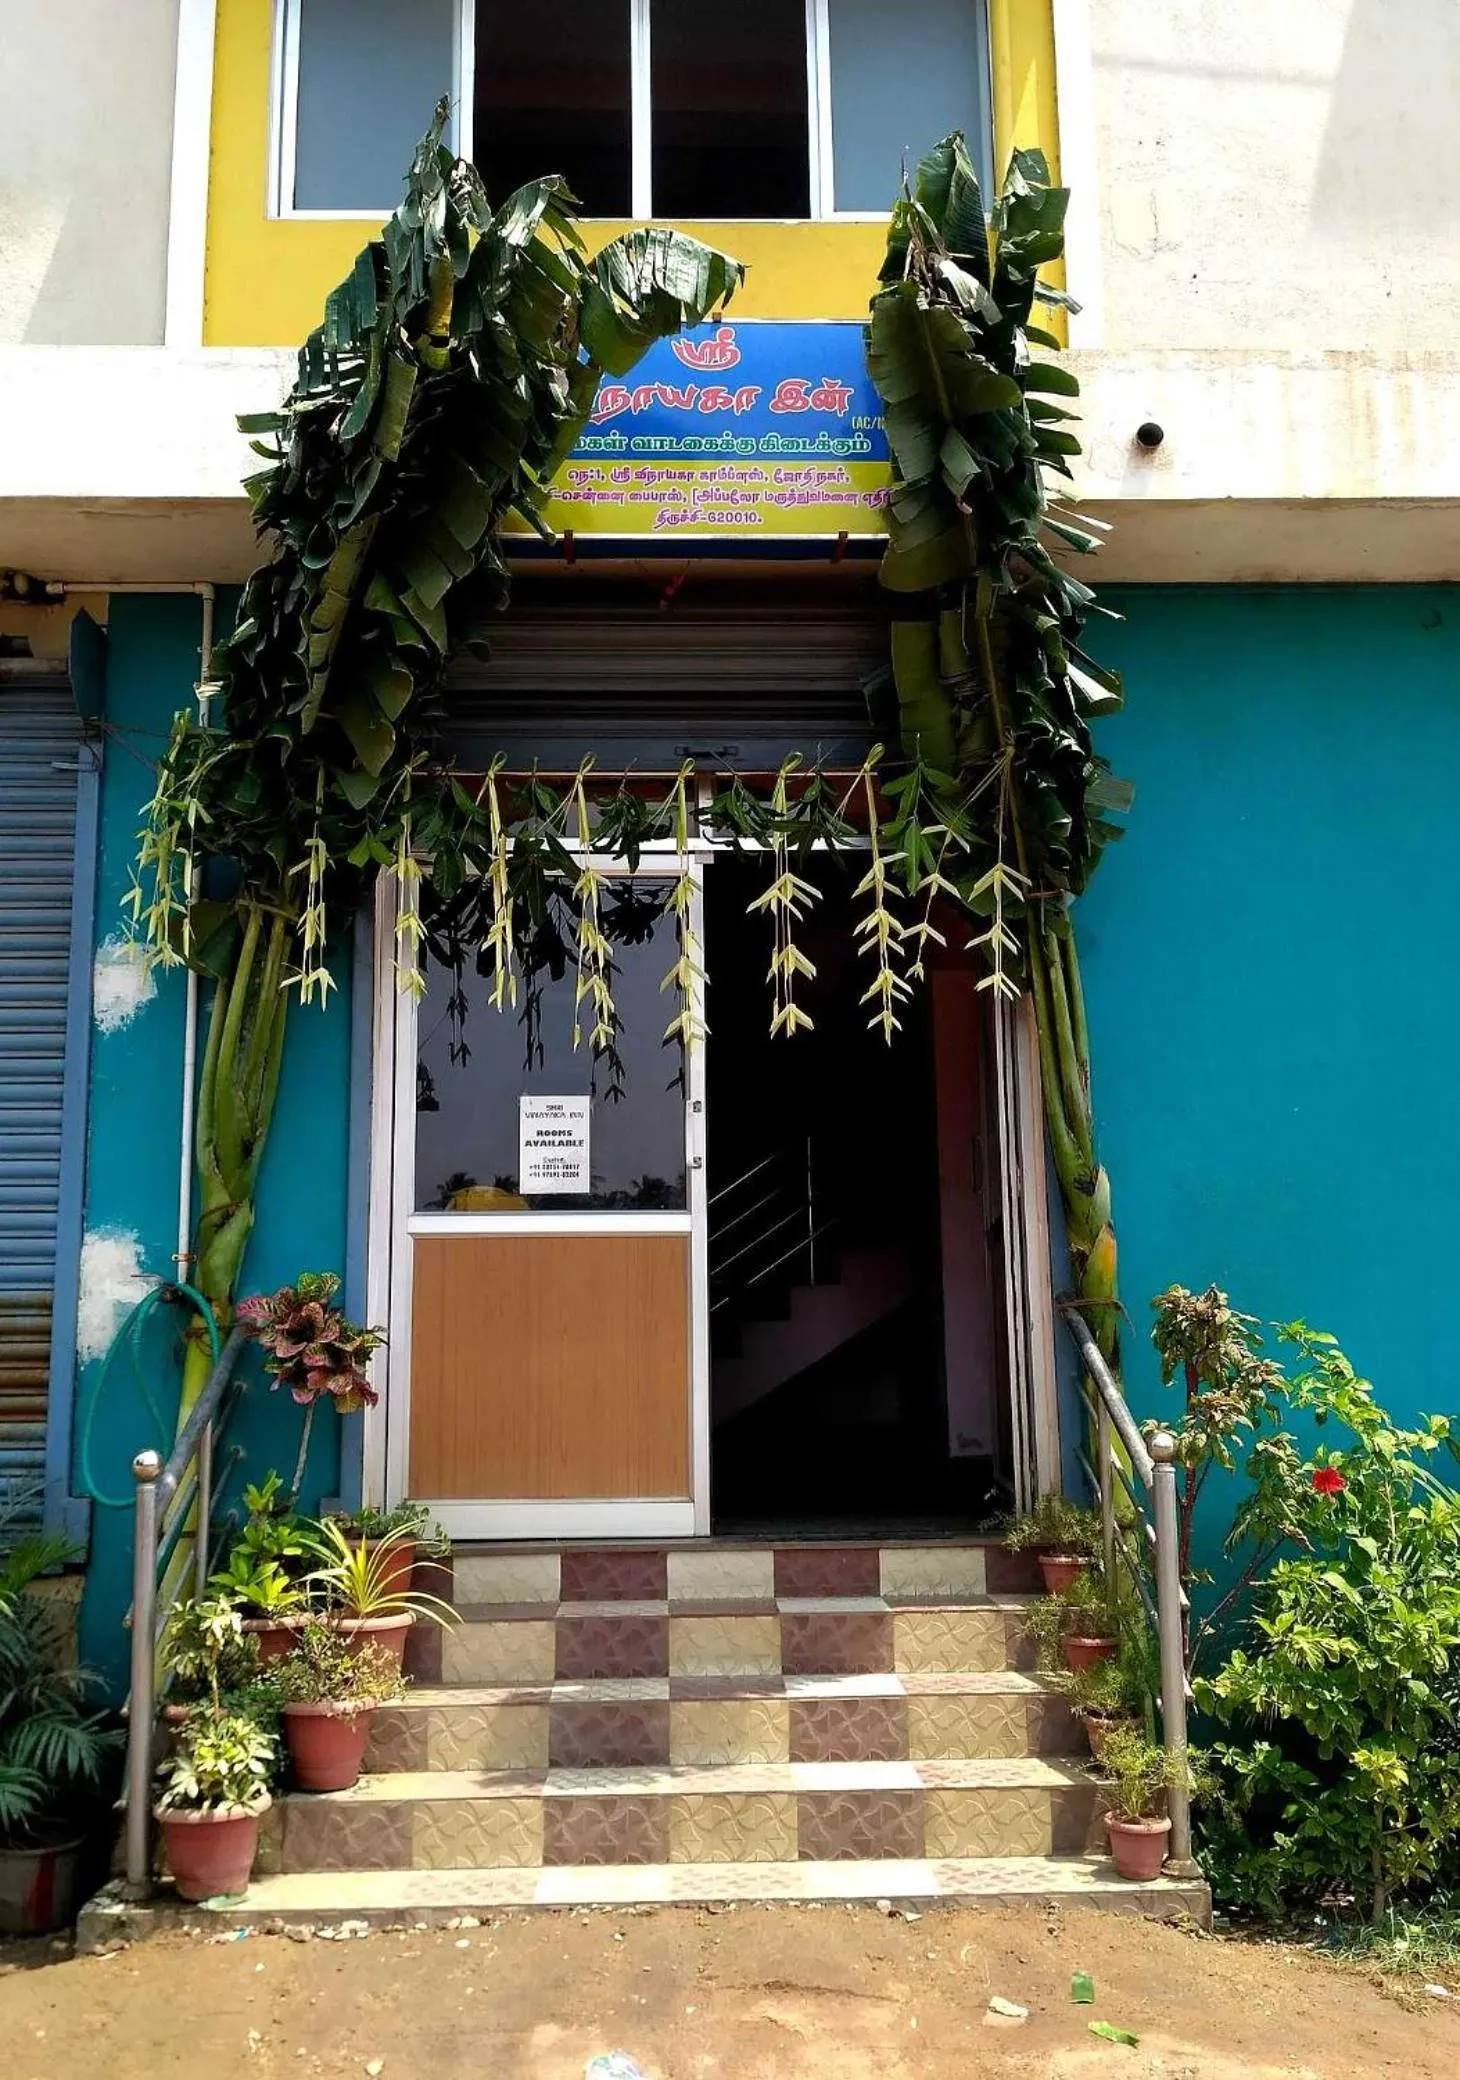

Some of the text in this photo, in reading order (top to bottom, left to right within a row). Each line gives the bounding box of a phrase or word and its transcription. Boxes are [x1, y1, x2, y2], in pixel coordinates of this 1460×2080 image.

[671, 326, 741, 371] ஸ்ரீ
[590, 376, 855, 425] நாயகா இன்
[632, 432, 756, 454] வாடகைக்கு
[758, 431, 872, 454] கிடைக்கும்
[609, 465, 632, 484] ஸ்ரீ
[633, 466, 696, 487] விநாயகா
[629, 487, 688, 504] பைபாஸ்,
[764, 487, 859, 508] மருத்துவமனை
[525, 1139, 585, 1148] AVAILABLE
[536, 1129, 573, 1137] ROOMS
